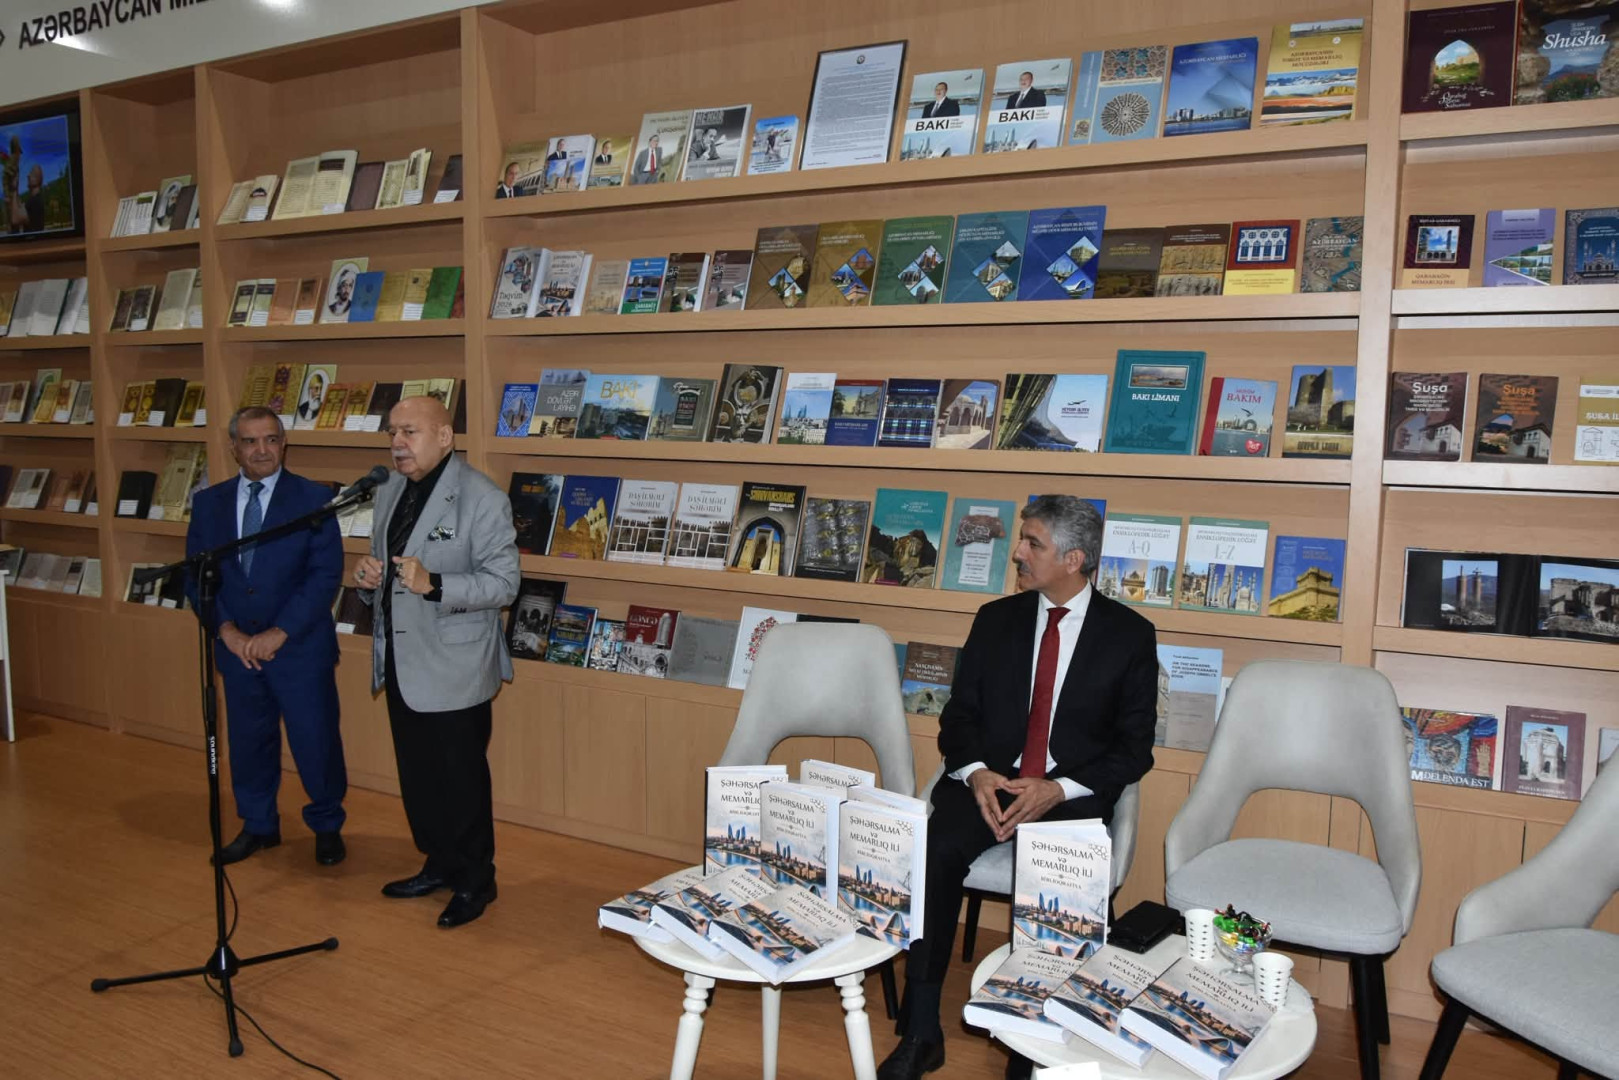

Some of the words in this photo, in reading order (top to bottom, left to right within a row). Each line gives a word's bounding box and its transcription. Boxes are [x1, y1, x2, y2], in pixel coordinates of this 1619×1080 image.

[19, 0, 162, 49] AZƏRBAYCAN
[1542, 30, 1607, 50] Shusha
[915, 119, 950, 132] BAKI
[999, 109, 1036, 123] BAKI
[1131, 393, 1151, 401] BAKI
[1151, 393, 1180, 402] LİMANI
[1412, 382, 1448, 394] Şuşa
[1227, 393, 1262, 404] BAKIM
[720, 779, 760, 790] ŞƏHƏRSA
[1422, 771, 1469, 785] DELENDA
[1470, 778, 1490, 788] EST
[768, 794, 815, 814] ŞƏHƏRSALMA
[769, 810, 805, 828] MEMARLIQ
[805, 818, 815, 830] İLİ
[849, 815, 901, 836] ŞƏHƏRSALMA
[849, 832, 889, 850] MEMARLIQ
[890, 844, 900, 853] İLİ
[1031, 840, 1094, 861] ŞƏHƏRSALMA
[1031, 857, 1080, 878] MEMARLIQ
[1081, 868, 1093, 879] İLİ
[1057, 856, 1067, 864] və
[729, 879, 759, 899] MEMARL
[738, 873, 772, 896] ŞƏHƏRSA
[1107, 961, 1147, 984] MEMARL
[1113, 954, 1158, 980] ŞƏHƏRSA
[1186, 972, 1239, 1005] MEMARLIQ
[1193, 966, 1259, 1005] ŞƏHƏRSALMA
